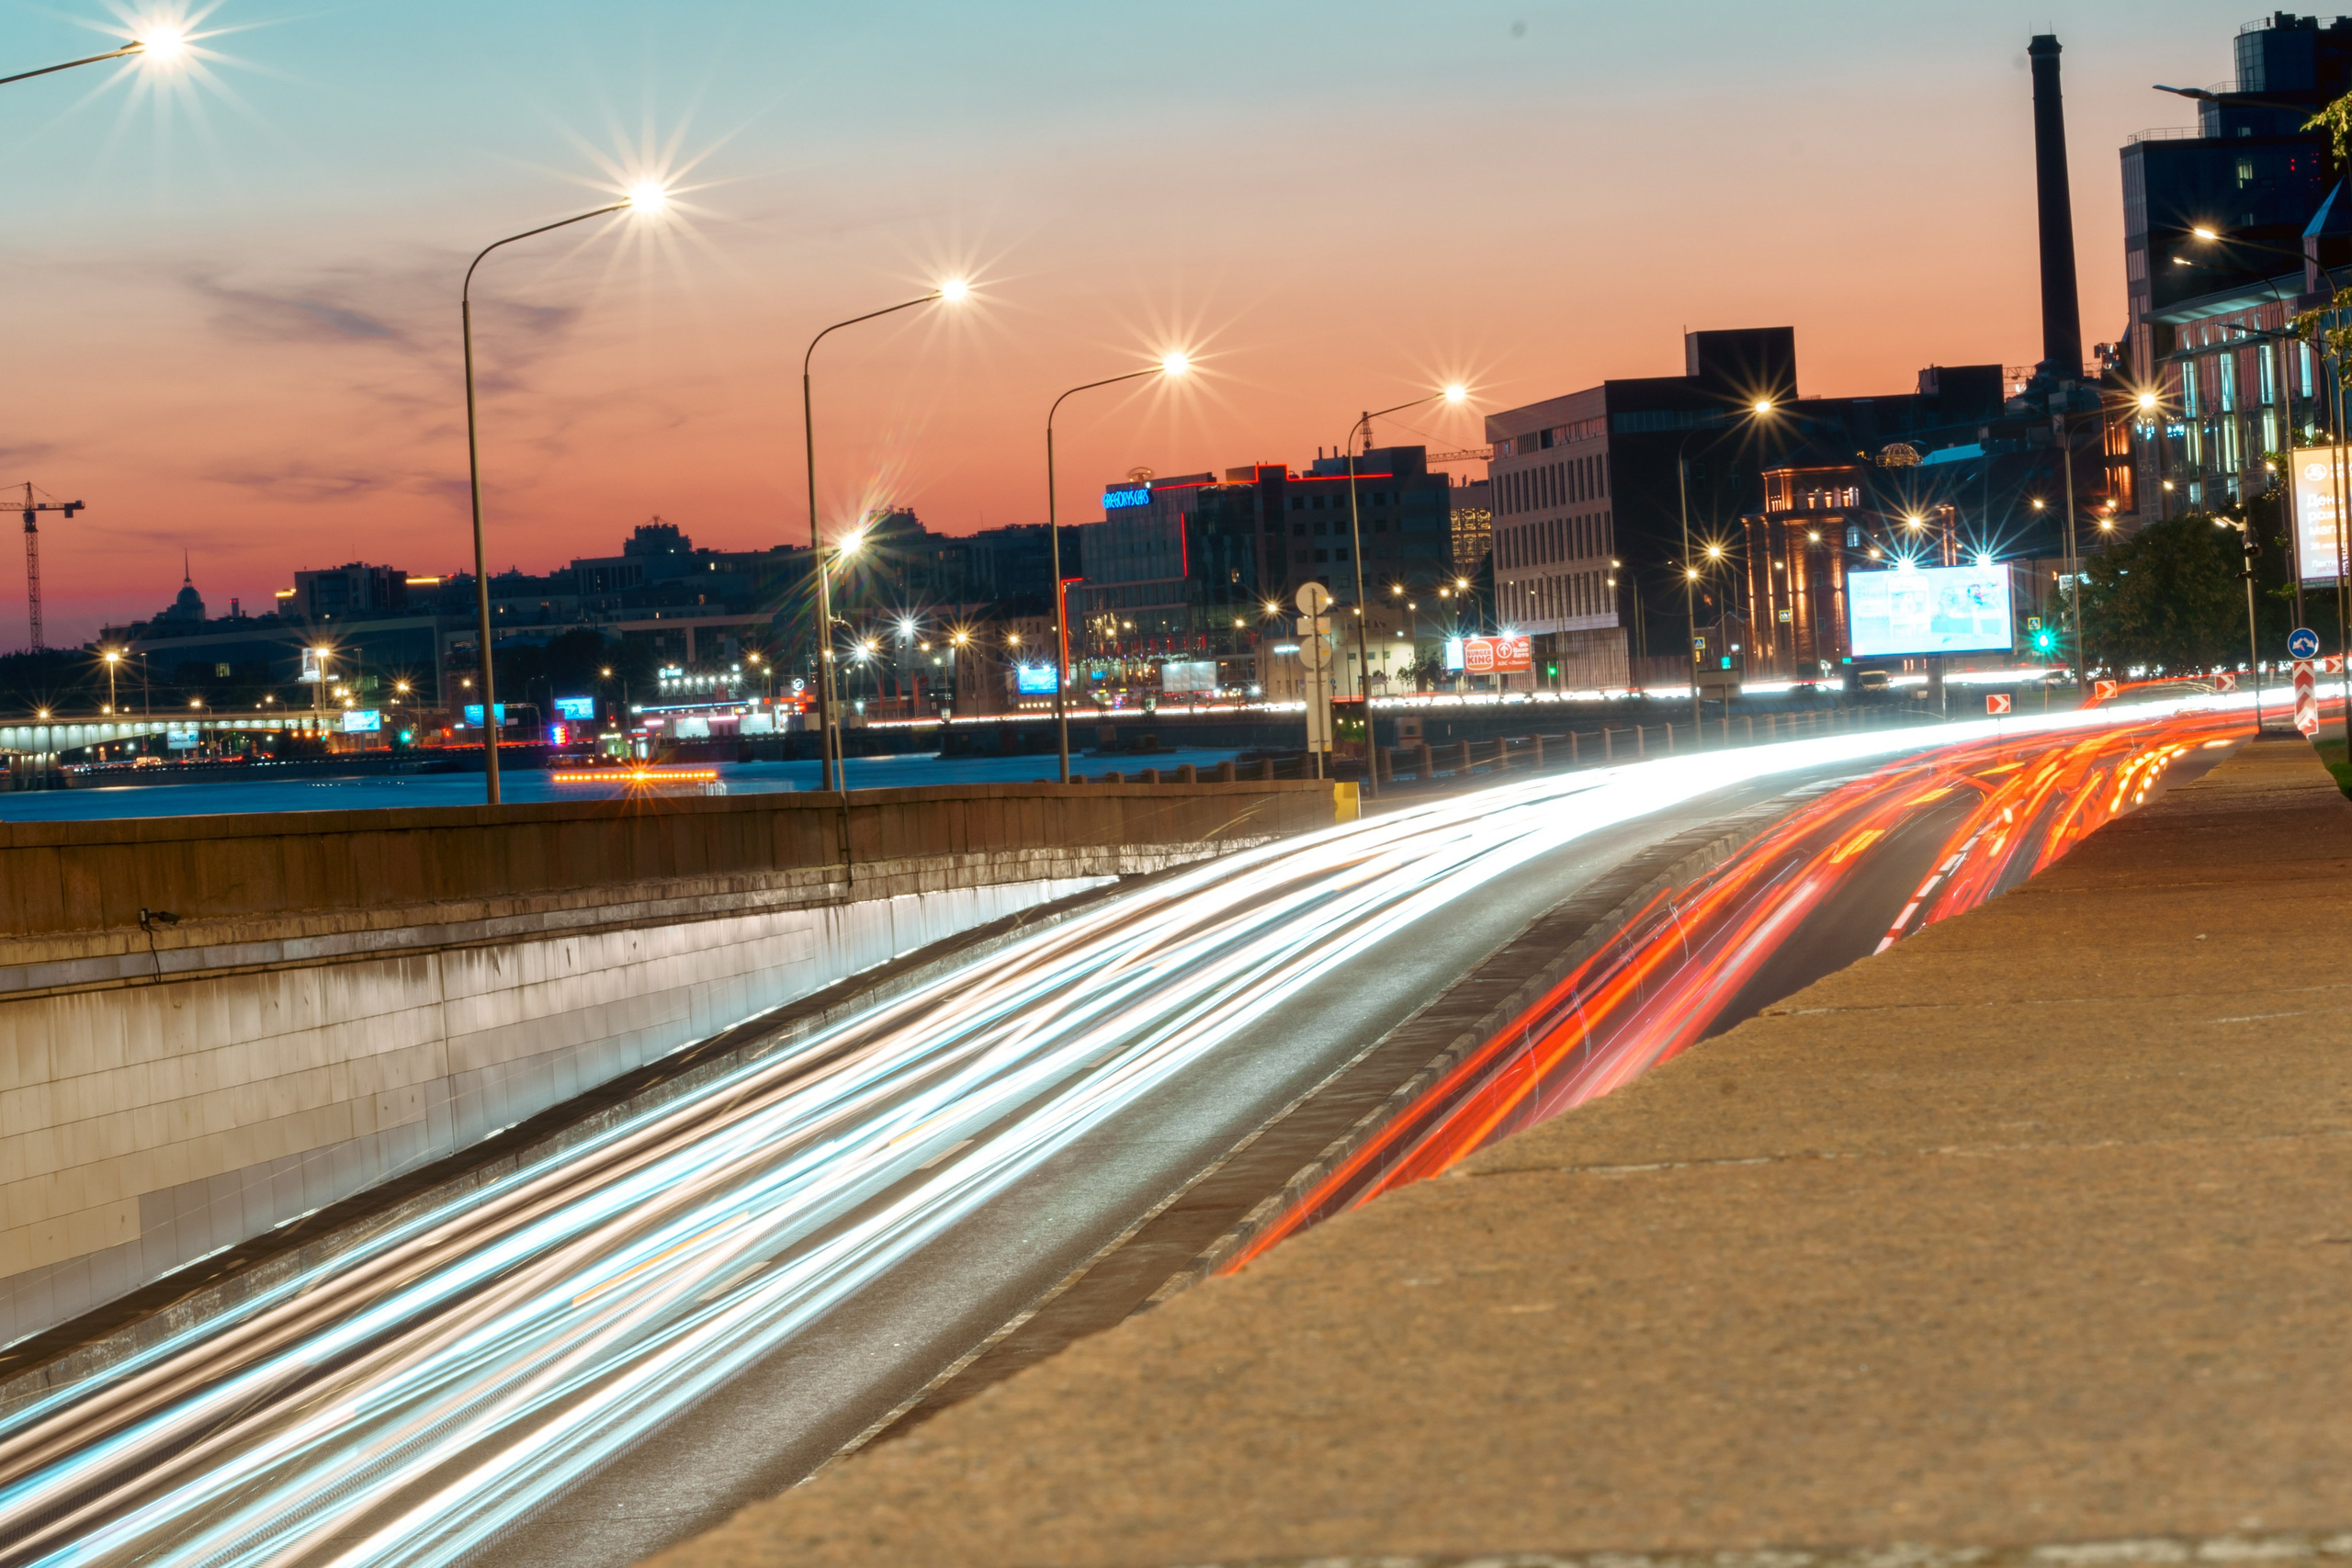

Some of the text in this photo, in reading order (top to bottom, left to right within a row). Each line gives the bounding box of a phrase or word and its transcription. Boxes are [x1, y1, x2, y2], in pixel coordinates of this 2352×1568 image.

[1135, 489, 1149, 505] CARS
[2307, 510, 2346, 525] рожд
[1467, 656, 1492, 664] KING
